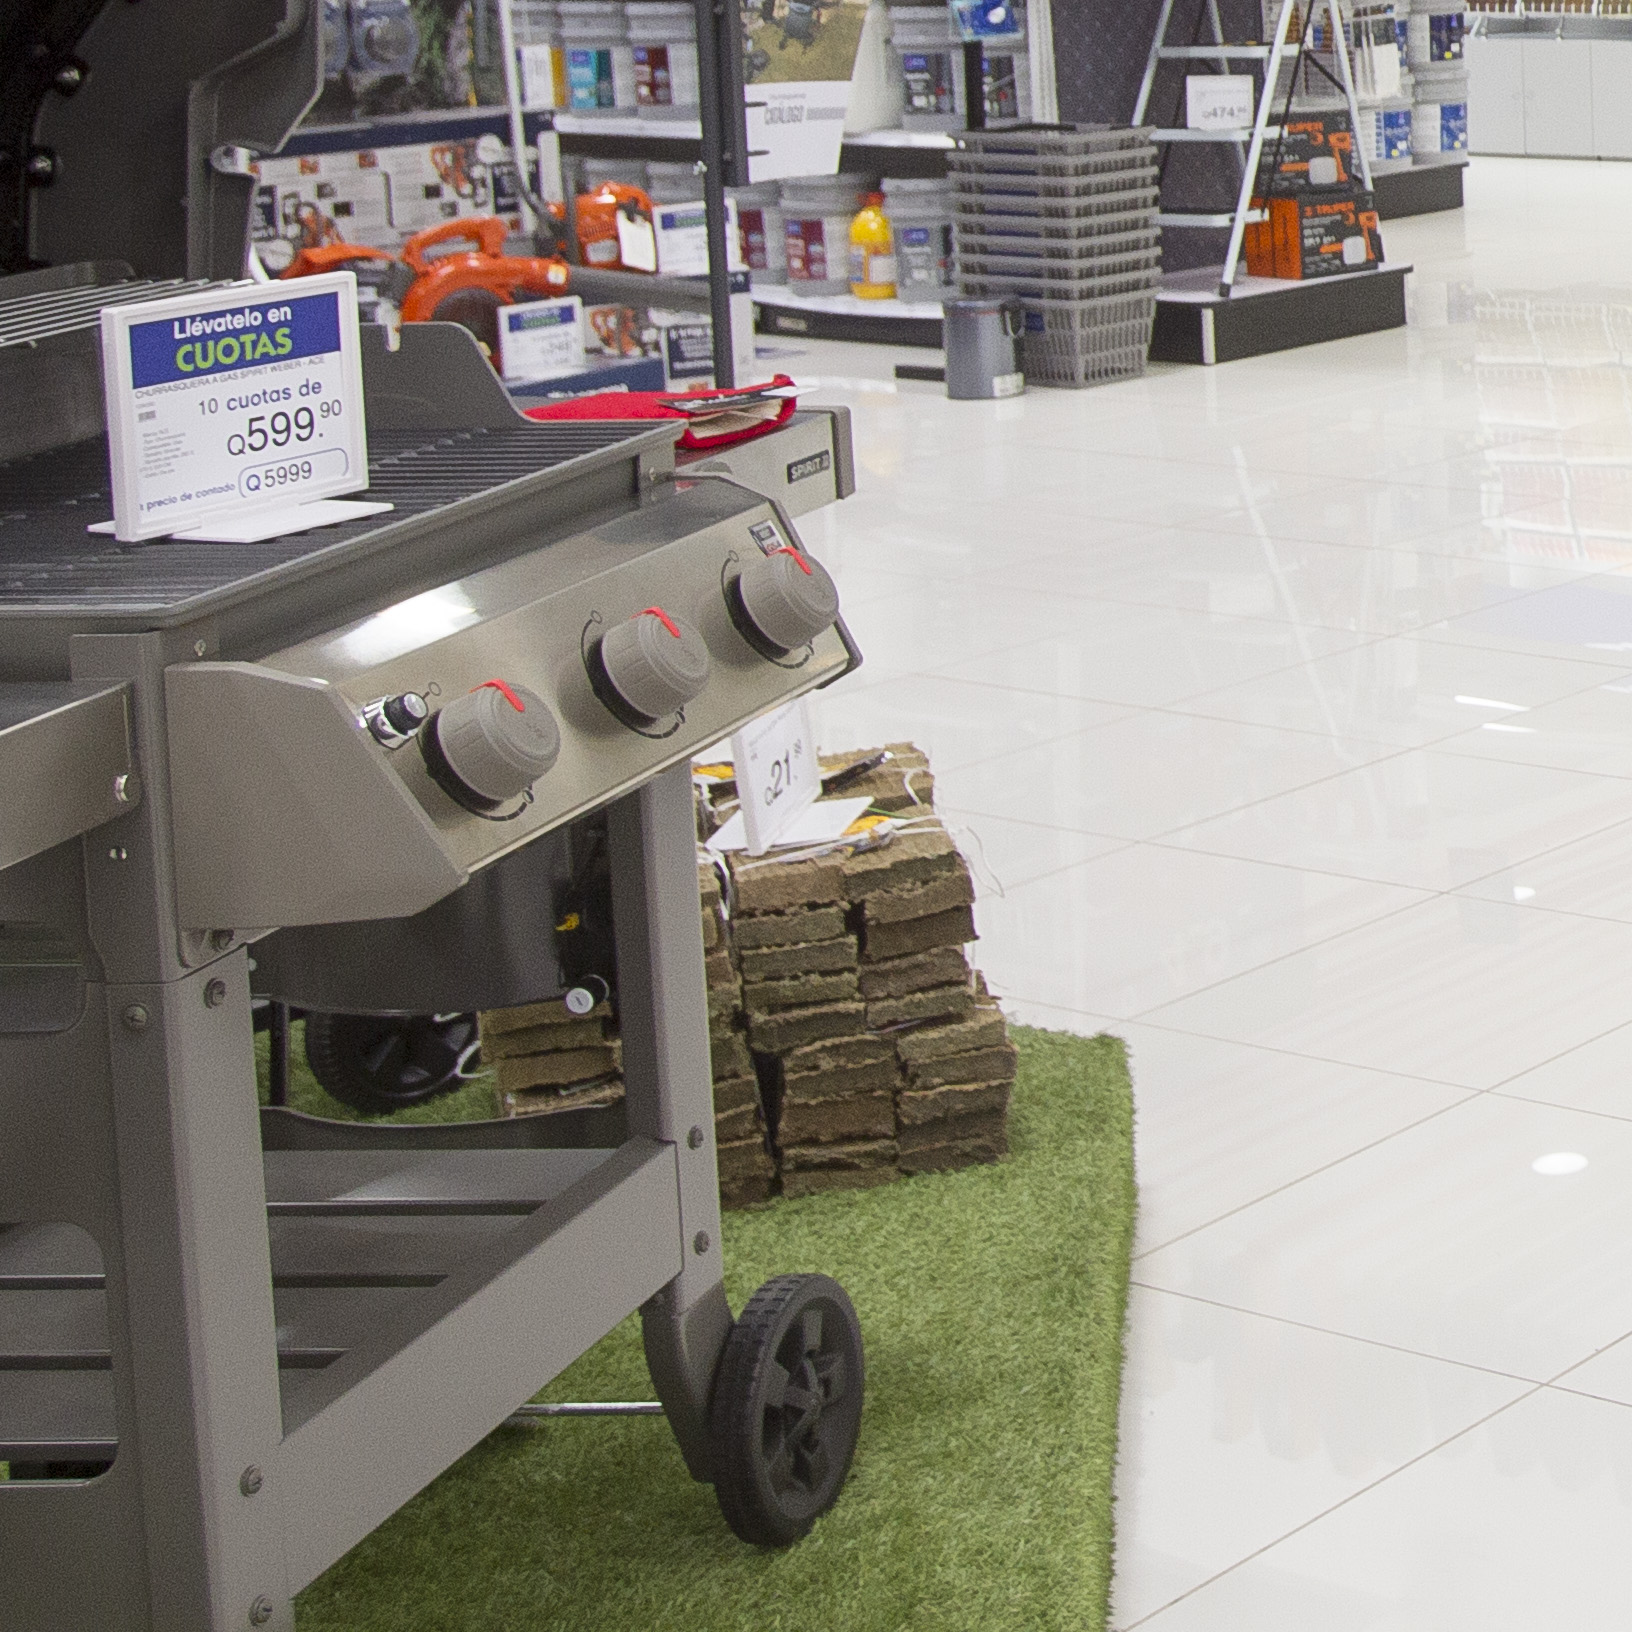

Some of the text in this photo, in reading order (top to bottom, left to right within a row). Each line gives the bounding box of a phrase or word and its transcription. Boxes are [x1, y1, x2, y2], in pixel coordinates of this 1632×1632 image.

[174, 306, 292, 339] Llévatelo en
[176, 328, 292, 371] CUOTAS
[199, 378, 322, 415] 10 cuotas de
[791, 457, 820, 480] SPIRIT
[147, 495, 178, 512] precio
[180, 492, 192, 502] de
[196, 483, 236, 499] contado
